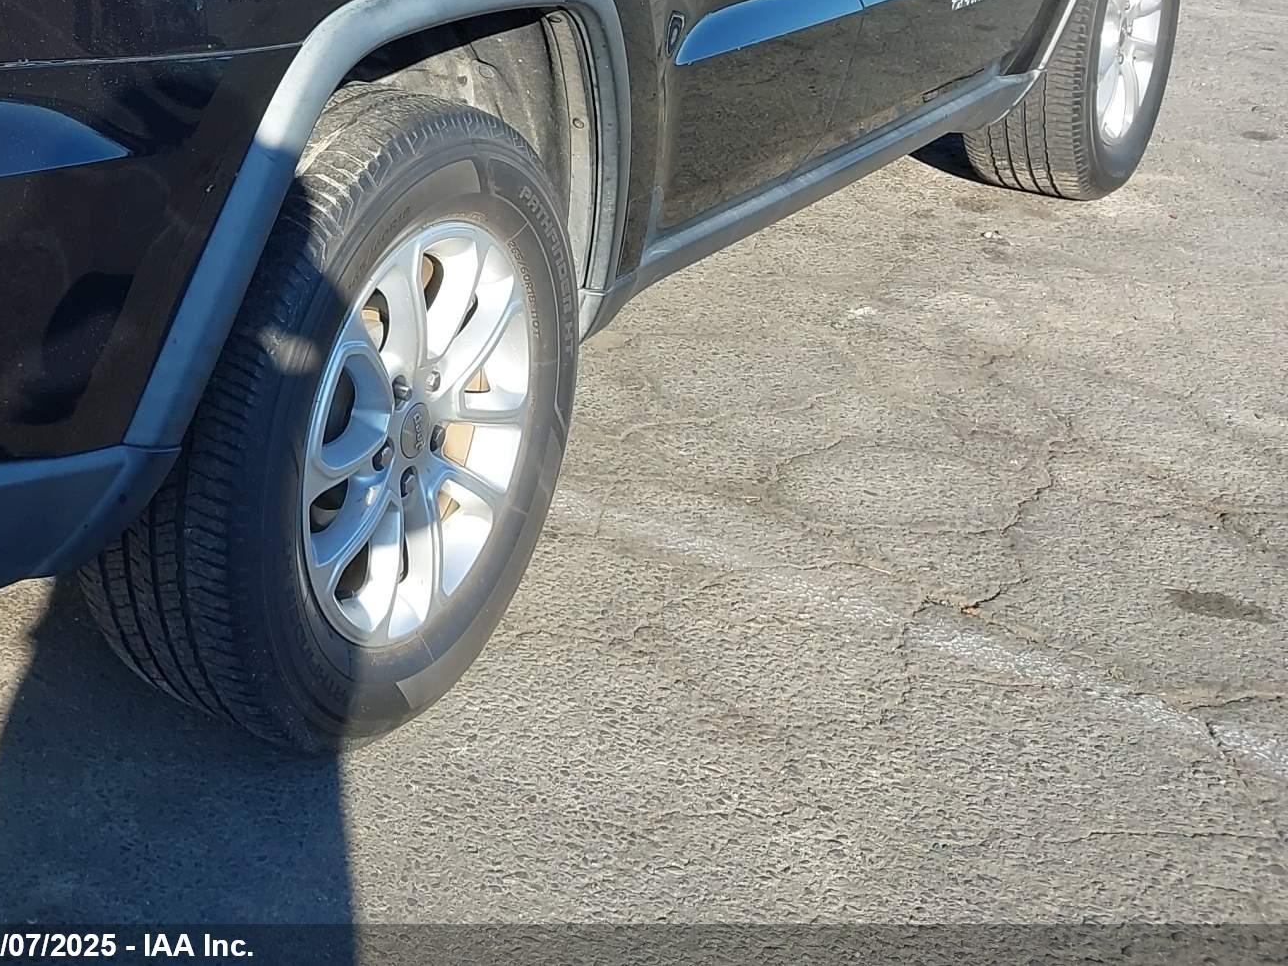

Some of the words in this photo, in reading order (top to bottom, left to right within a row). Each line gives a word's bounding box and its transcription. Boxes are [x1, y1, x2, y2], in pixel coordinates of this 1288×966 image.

[507, 240, 537, 303] 265/60R18
[518, 185, 573, 310] PATHFINDER
[413, 413, 426, 451] Jeep
